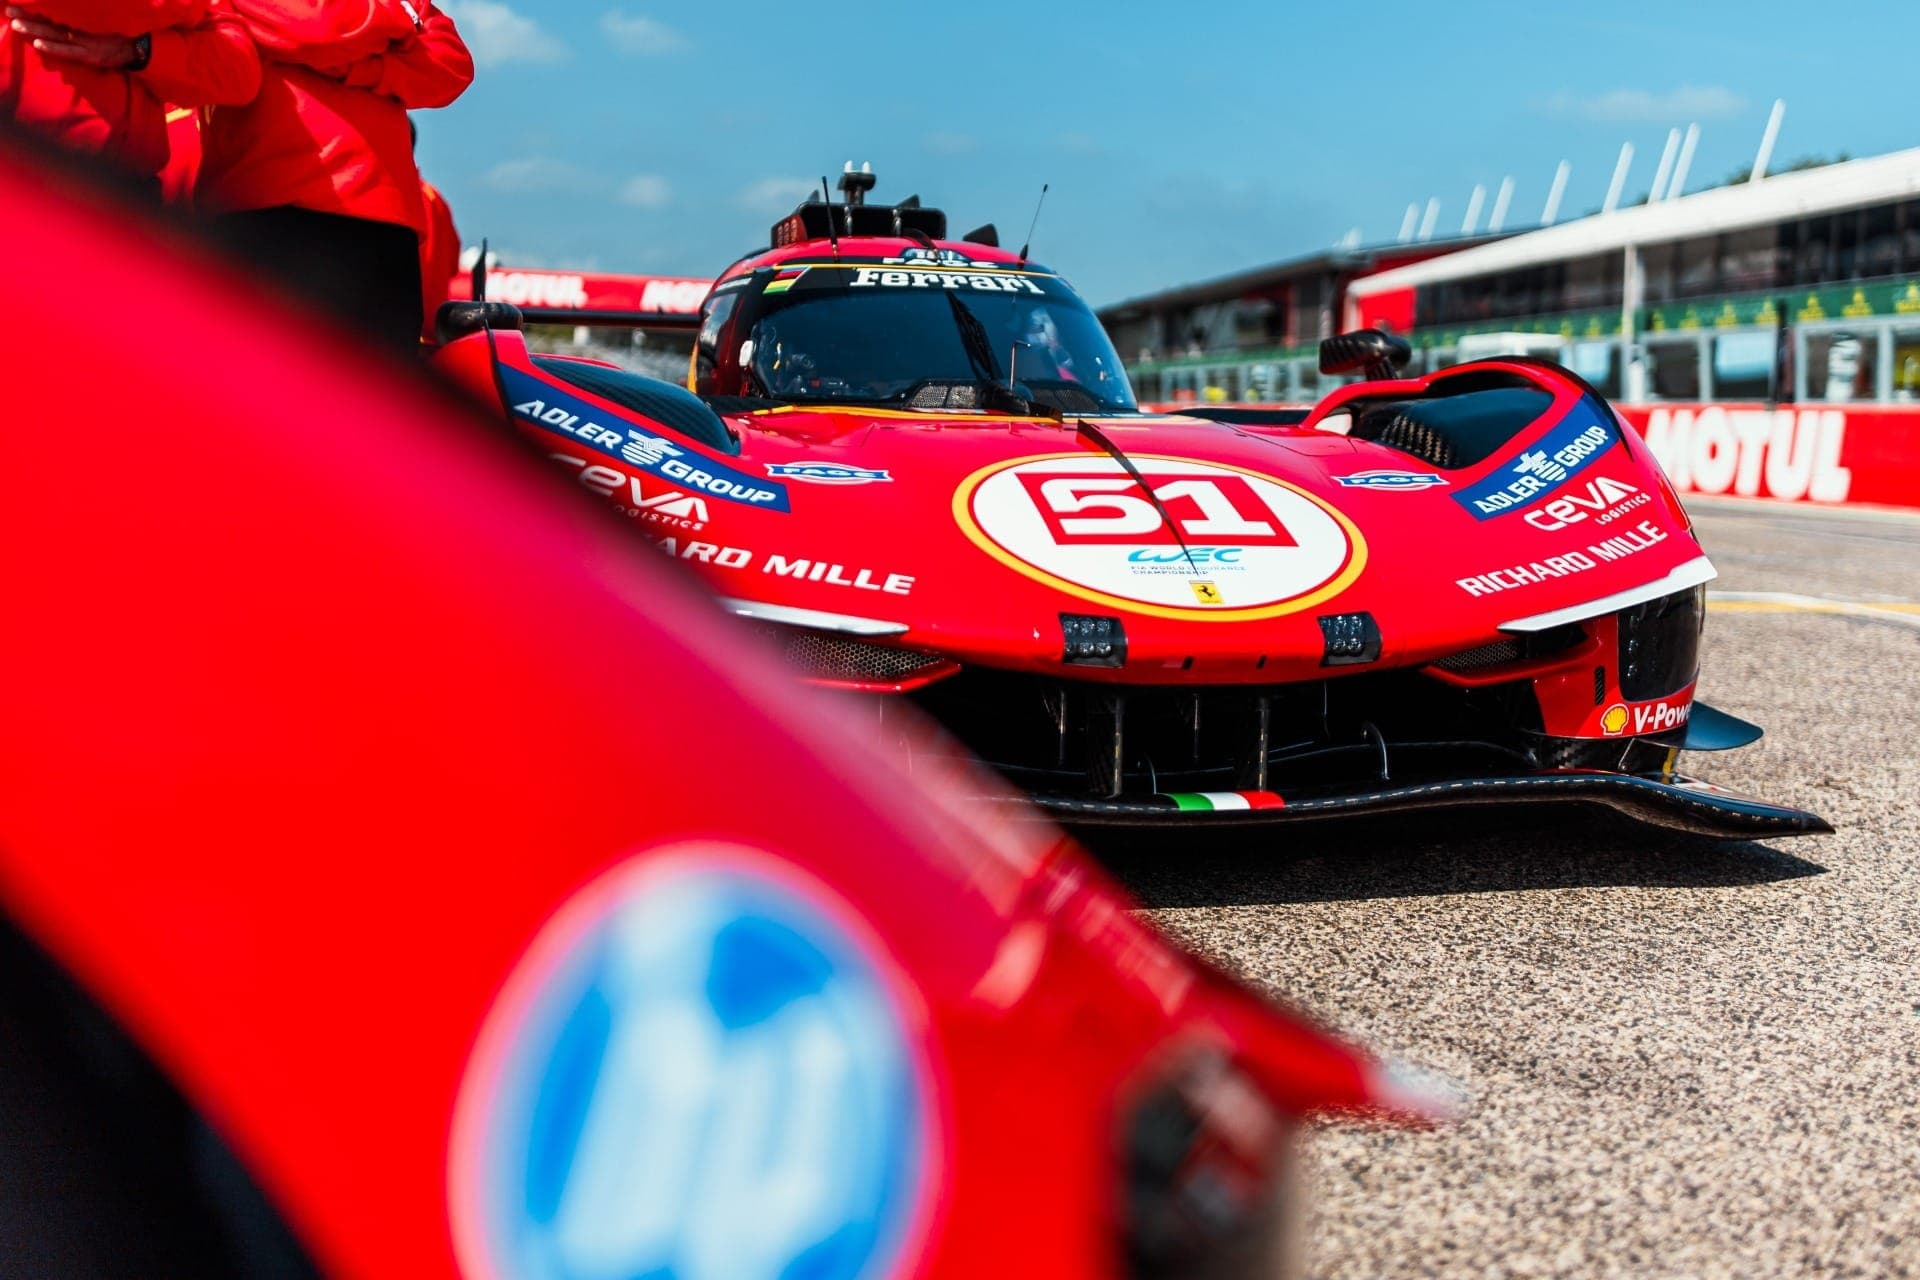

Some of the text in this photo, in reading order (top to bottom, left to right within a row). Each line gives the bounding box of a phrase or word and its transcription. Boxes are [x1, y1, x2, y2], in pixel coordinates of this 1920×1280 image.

[849, 267, 1045, 294] Ferrari
[513, 399, 777, 503] ADLER GROUP
[1472, 425, 1609, 514] ADLER GROUP
[1644, 406, 1851, 502] MOTUL
[612, 504, 704, 532] OGISTICS
[1040, 477, 1277, 537] 51
[1595, 491, 1652, 526] LOGISTICS
[762, 554, 916, 595] MILLE
[1127, 547, 1243, 563] WEC
[1456, 520, 1668, 598] RICHARD MILLE
